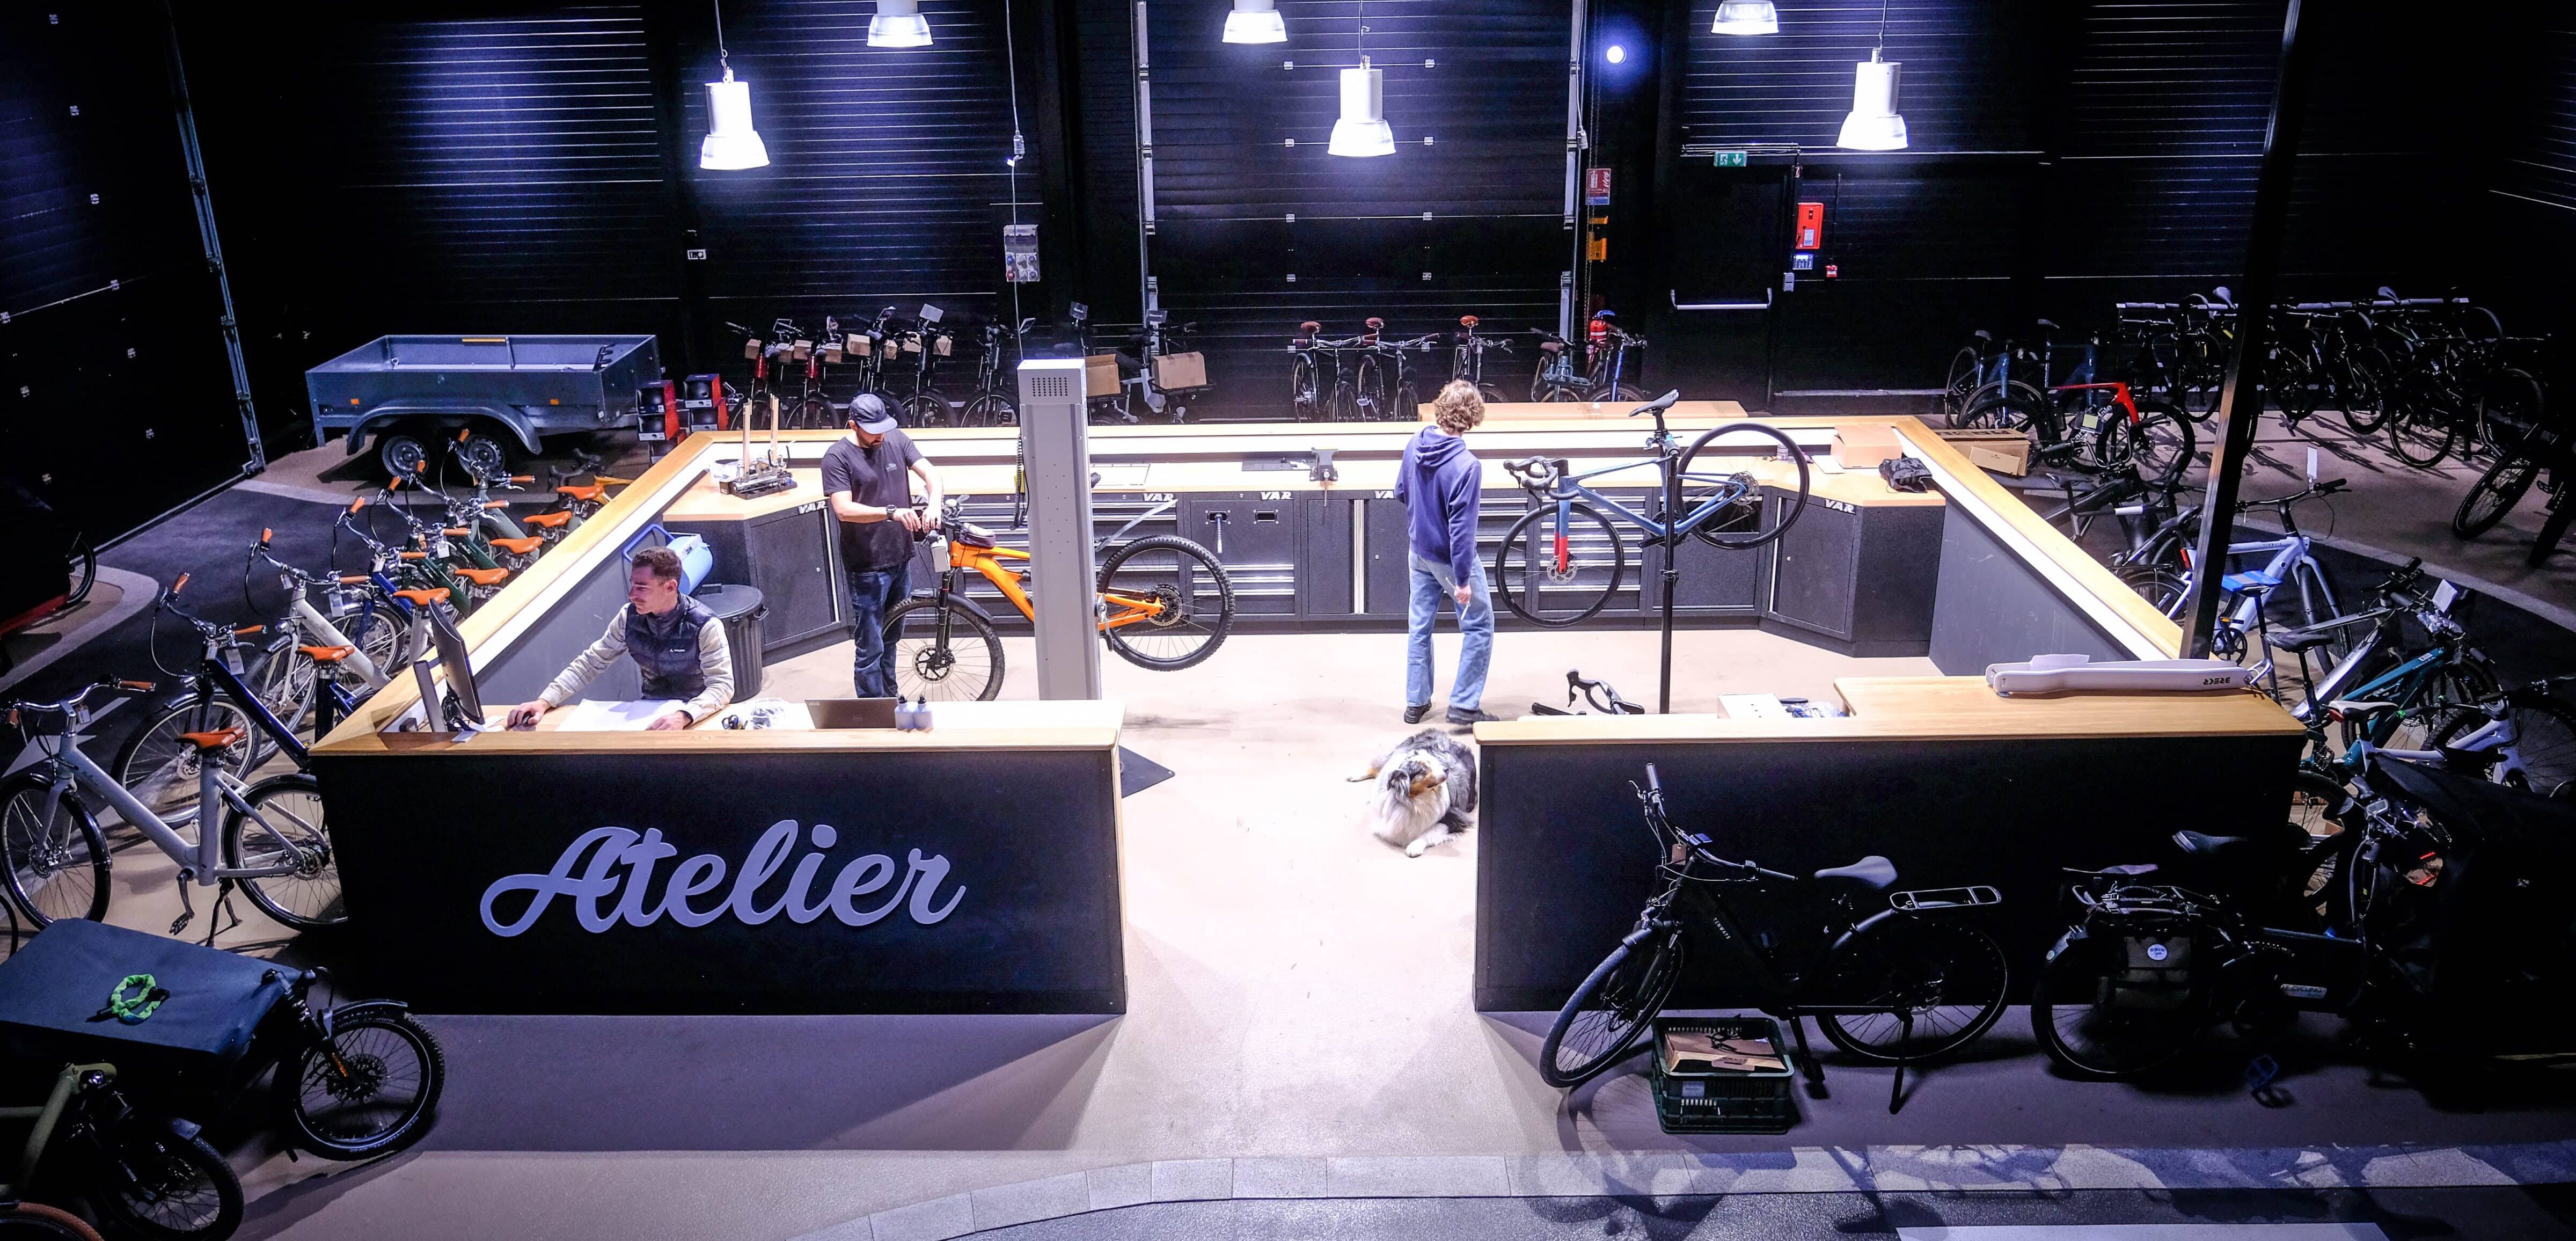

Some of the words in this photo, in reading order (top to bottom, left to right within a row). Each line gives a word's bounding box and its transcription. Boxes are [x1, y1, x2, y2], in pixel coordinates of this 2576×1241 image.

[910, 495, 928, 503] VA
[1142, 493, 1175, 501] VAR
[1261, 491, 1294, 500] VAR
[1374, 491, 1394, 499] VA
[798, 500, 828, 514] VAR
[1825, 499, 1856, 514] VAR
[479, 819, 966, 938] Atelier
[1713, 917, 1731, 939] TENWAYS
